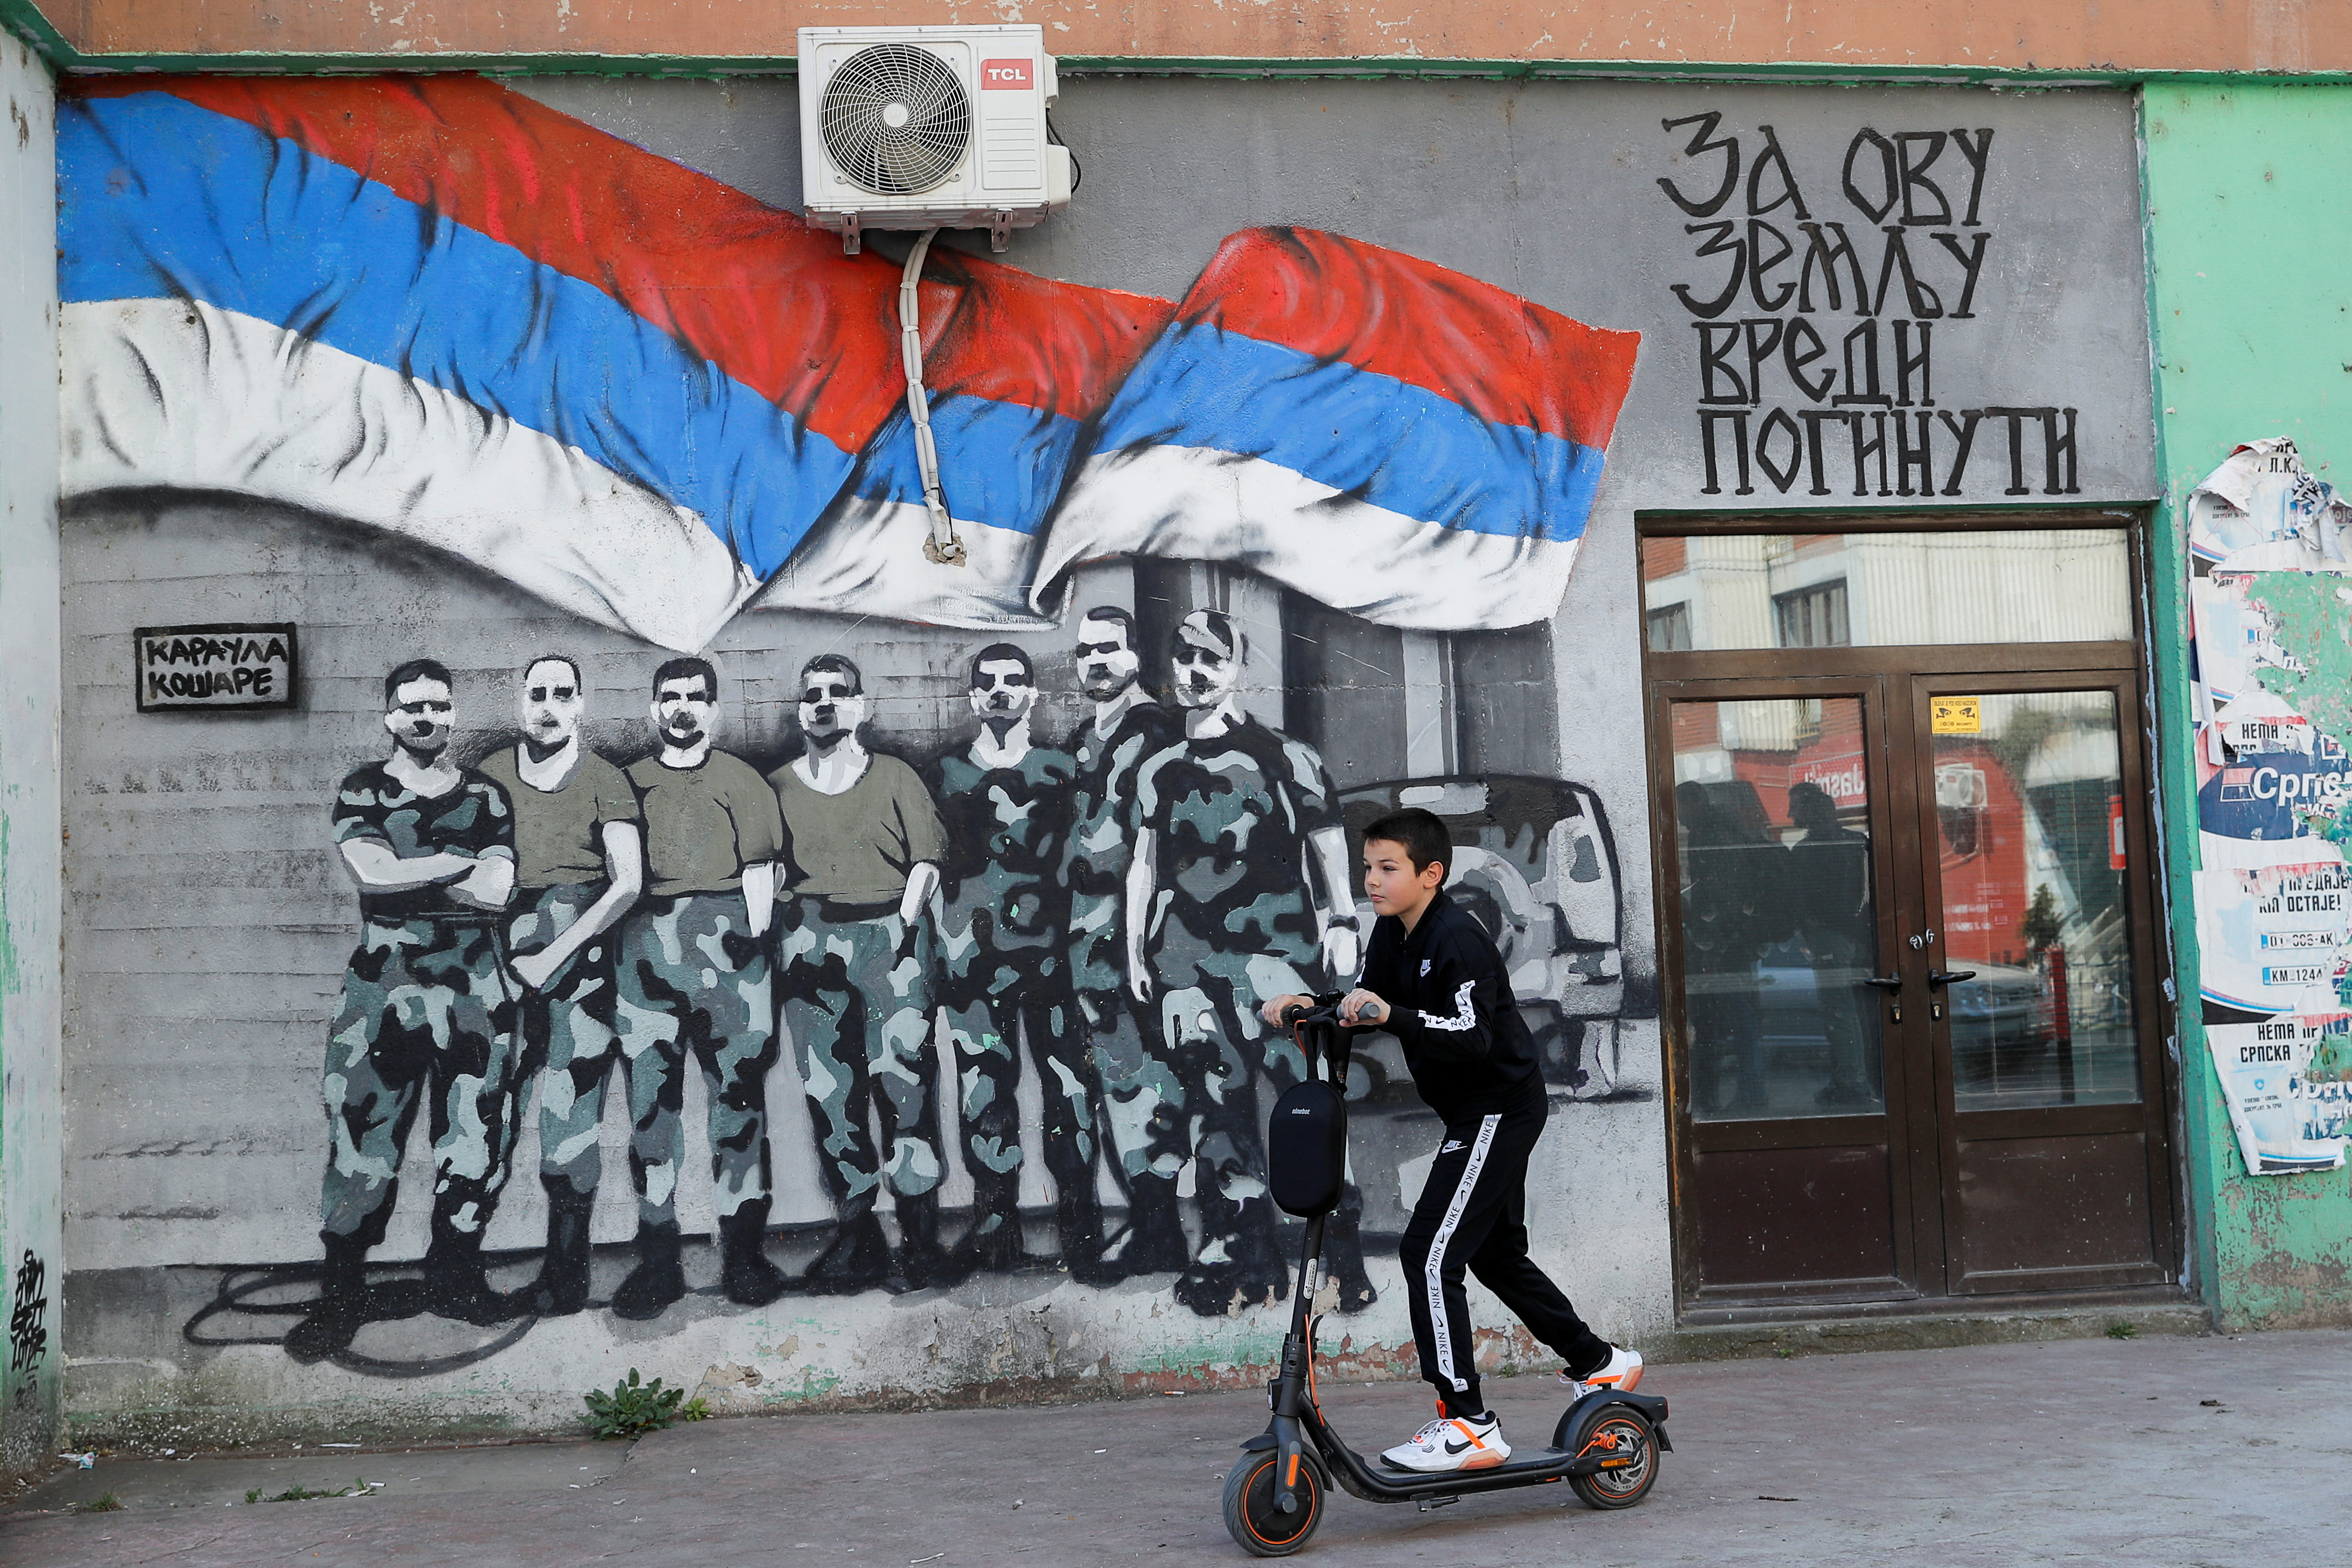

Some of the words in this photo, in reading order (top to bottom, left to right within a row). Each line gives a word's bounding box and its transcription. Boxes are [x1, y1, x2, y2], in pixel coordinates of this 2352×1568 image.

[987, 68, 1026, 81] TCL
[1657, 111, 1811, 220] ЗА
[1842, 126, 1994, 226] ОВУ
[1697, 407, 2081, 497] ПОГИНУТИ
[146, 637, 288, 666] КАРАУЛА
[148, 667, 273, 699] КОШАРЕ
[2287, 894, 2341, 912] ОСТАЈЕ!
[2258, 1024, 2294, 1040] НЕМА
[2240, 1045, 2290, 1063] СРПСКА
[1445, 1140, 1462, 1149] NIKE
[1480, 1121, 1494, 1145] NIKE
[1463, 1164, 1478, 1188] NIKE
[1445, 1206, 1460, 1228] NIKE
[1429, 1246, 1442, 1270] NIKE
[1431, 1285, 1441, 1309] NIKE
[1437, 1332, 1448, 1355] NIKE
